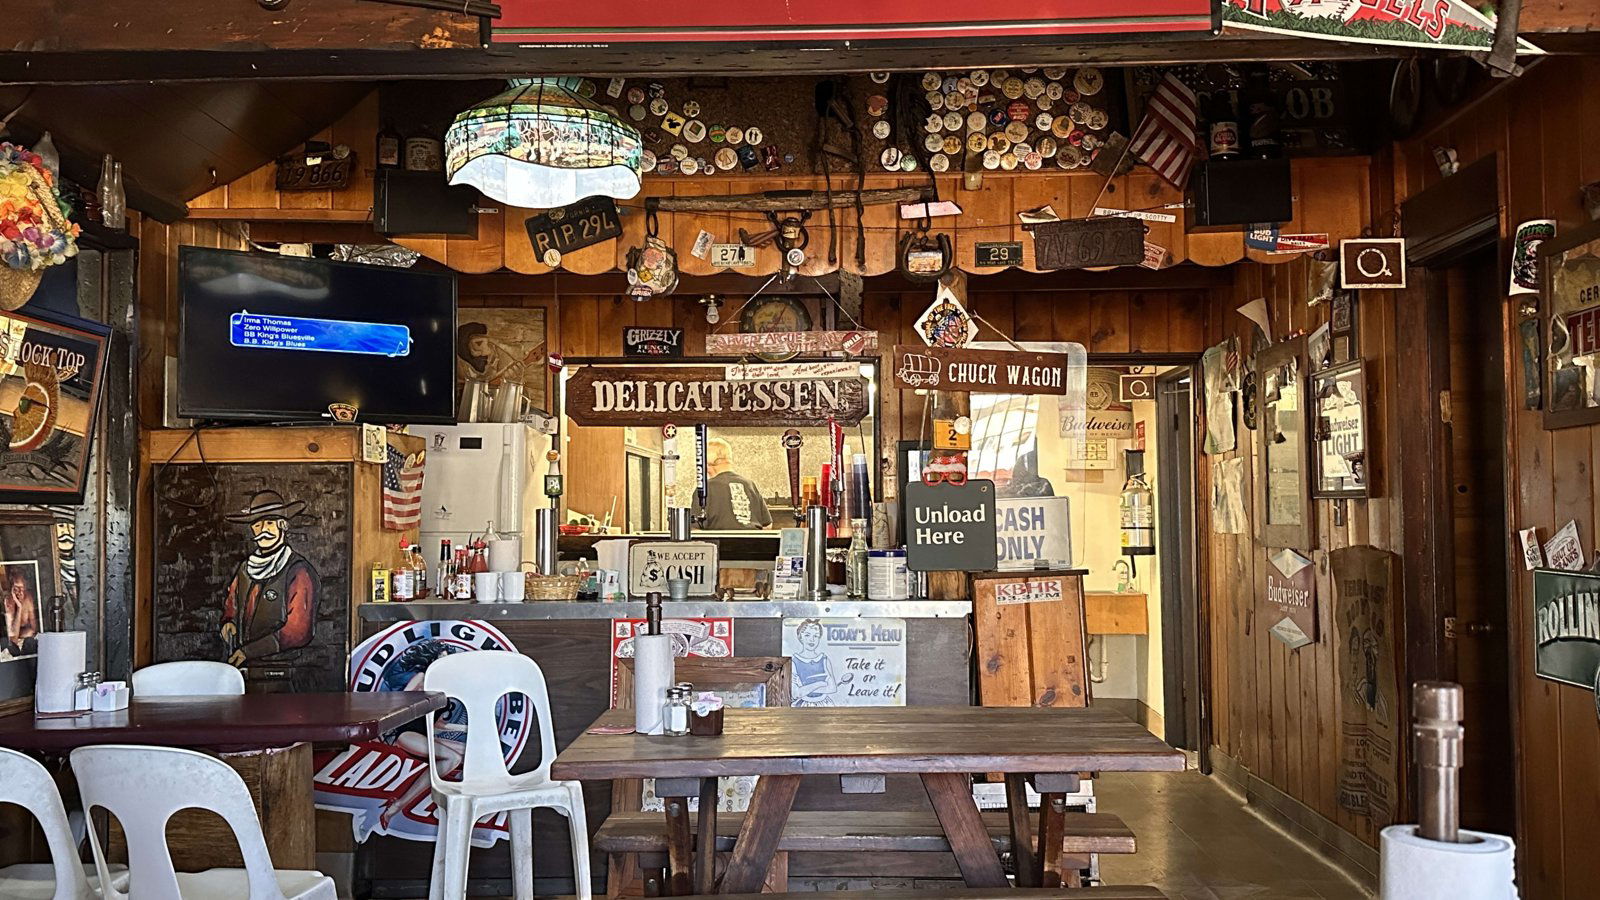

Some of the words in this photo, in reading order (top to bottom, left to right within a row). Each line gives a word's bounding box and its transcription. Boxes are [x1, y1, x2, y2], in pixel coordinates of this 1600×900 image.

[536, 224, 573, 253] RIP
[1250, 233, 1274, 243] LIGHT
[990, 247, 1009, 260] 29
[263, 318, 292, 326] Thomas
[263, 325, 298, 333] Willpower
[257, 332, 280, 340] King's
[281, 333, 315, 342] Bluesville
[261, 339, 284, 347] King's
[627, 328, 681, 346] GRIZZLY
[765, 332, 803, 345] ARGUE
[55, 347, 86, 374] TOP
[948, 362, 998, 385] CHUCK
[1006, 365, 1062, 388] WAGON
[592, 380, 842, 412] DELICATESSEN
[1062, 415, 1132, 432] Budweiser
[948, 429, 957, 442] 2
[1326, 432, 1359, 456] LIGHT
[915, 502, 986, 525] Unload
[996, 506, 1045, 532] CASH
[916, 527, 965, 545] Here
[657, 552, 671, 561] WE
[672, 552, 706, 561] ACCEPT
[997, 535, 1045, 561] ONLY
[666, 564, 705, 585] CASH
[997, 581, 1060, 596] KBHR
[1268, 575, 1309, 607] Budweiser
[357, 643, 395, 693] UD
[845, 657, 871, 671] Take
[875, 658, 886, 671] it
[863, 674, 876, 683] or
[848, 683, 879, 697] Leave
[882, 683, 902, 698] it!
[313, 743, 429, 792] LADY
